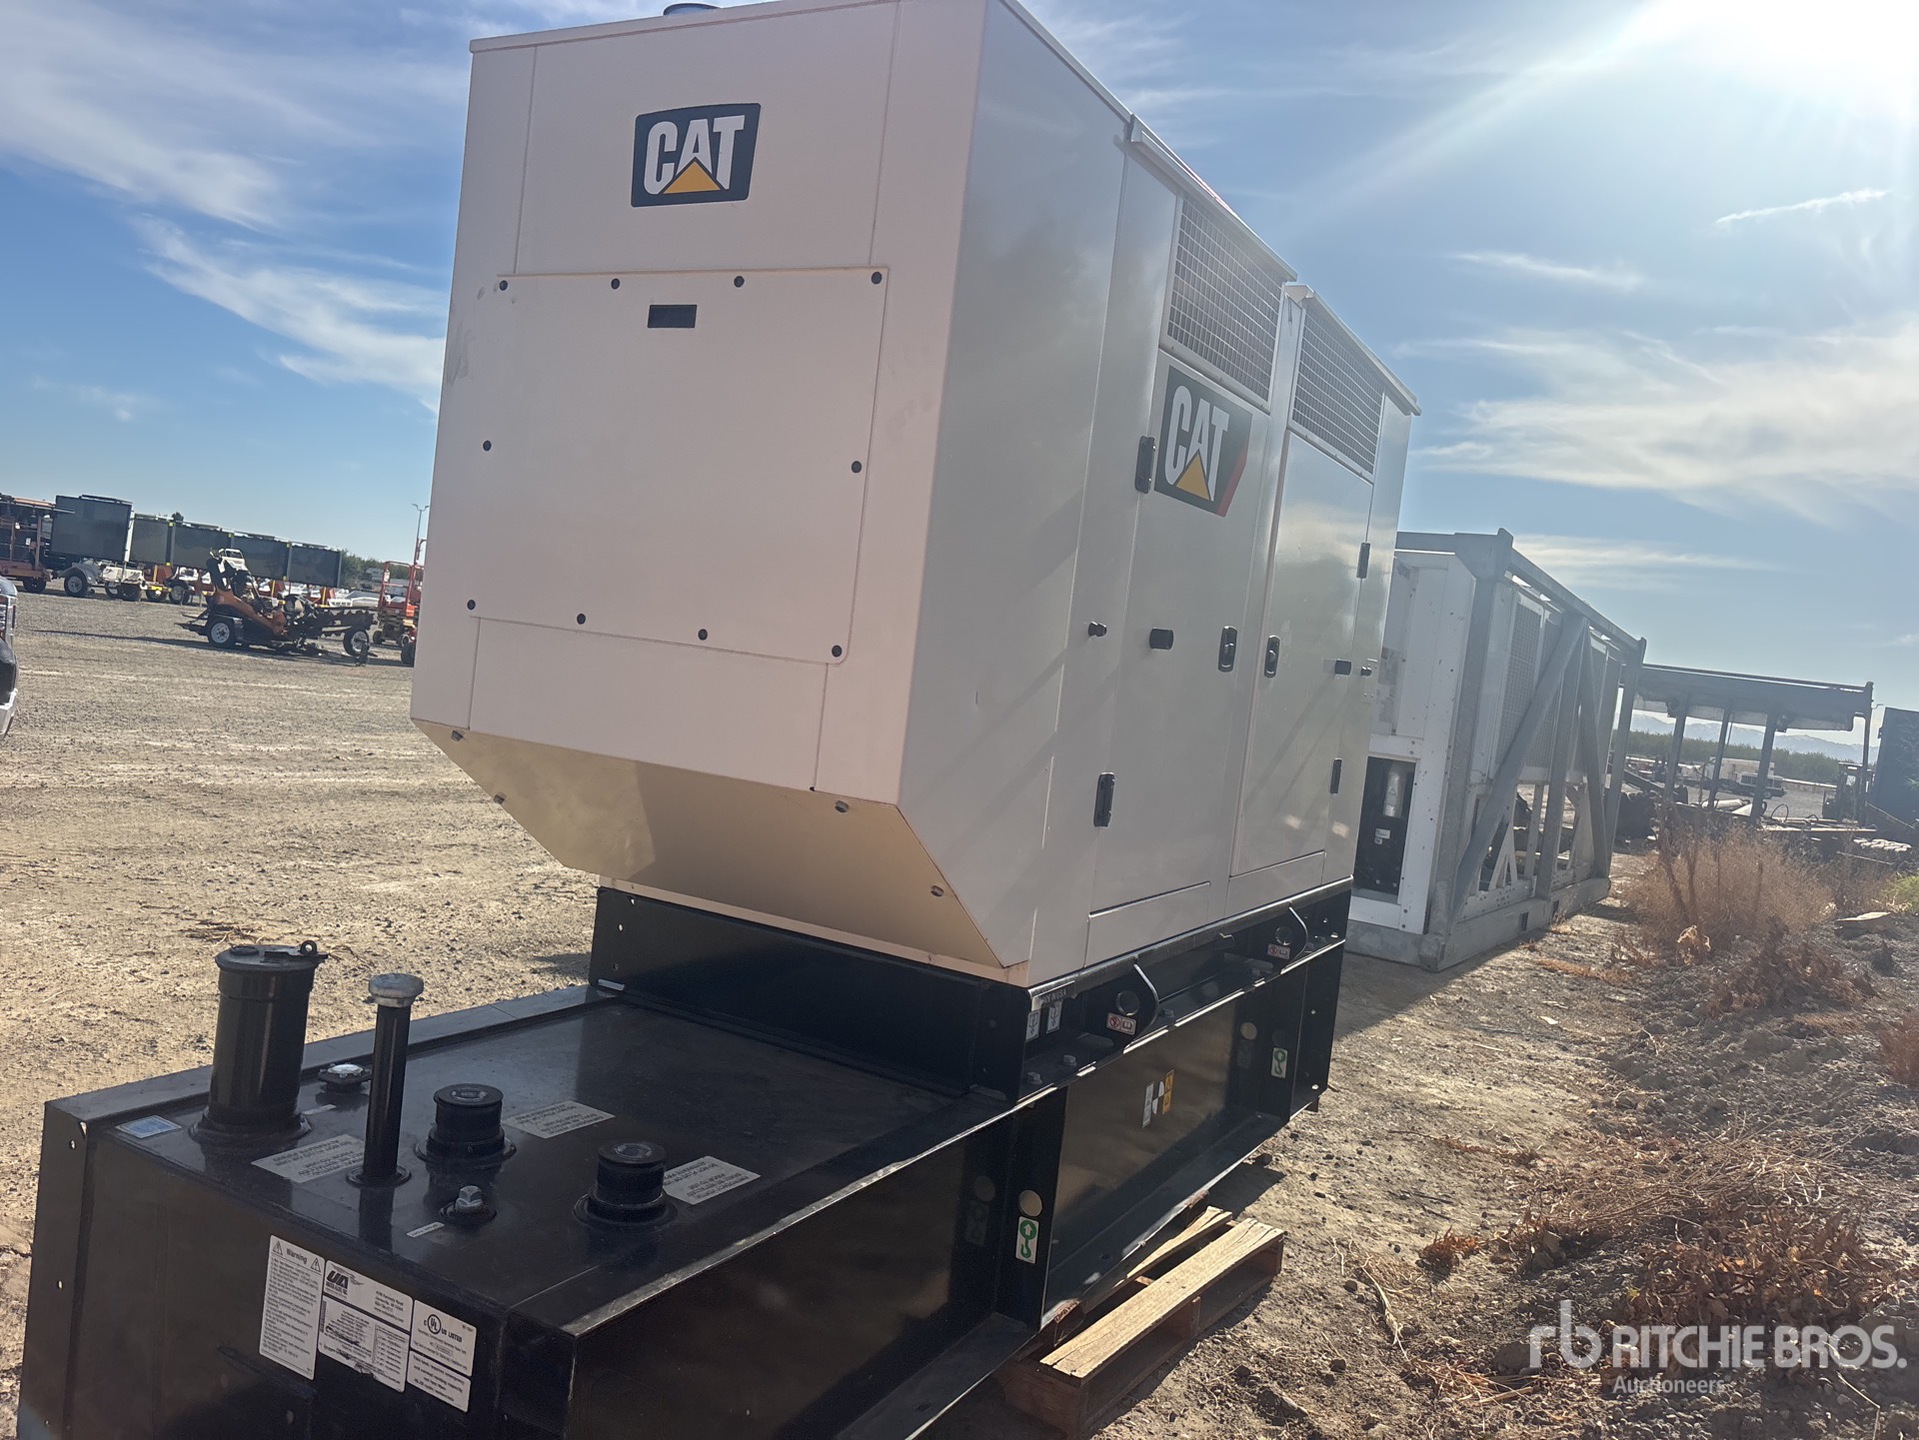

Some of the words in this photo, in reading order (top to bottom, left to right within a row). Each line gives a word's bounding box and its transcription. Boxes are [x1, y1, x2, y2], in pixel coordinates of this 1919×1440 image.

[644, 115, 745, 195] CAT
[1165, 385, 1230, 501] CAT
[286, 1248, 308, 1265] Warning
[326, 1271, 349, 1290] UA
[441, 1327, 447, 1336] US
[448, 1332, 463, 1343] LISTED
